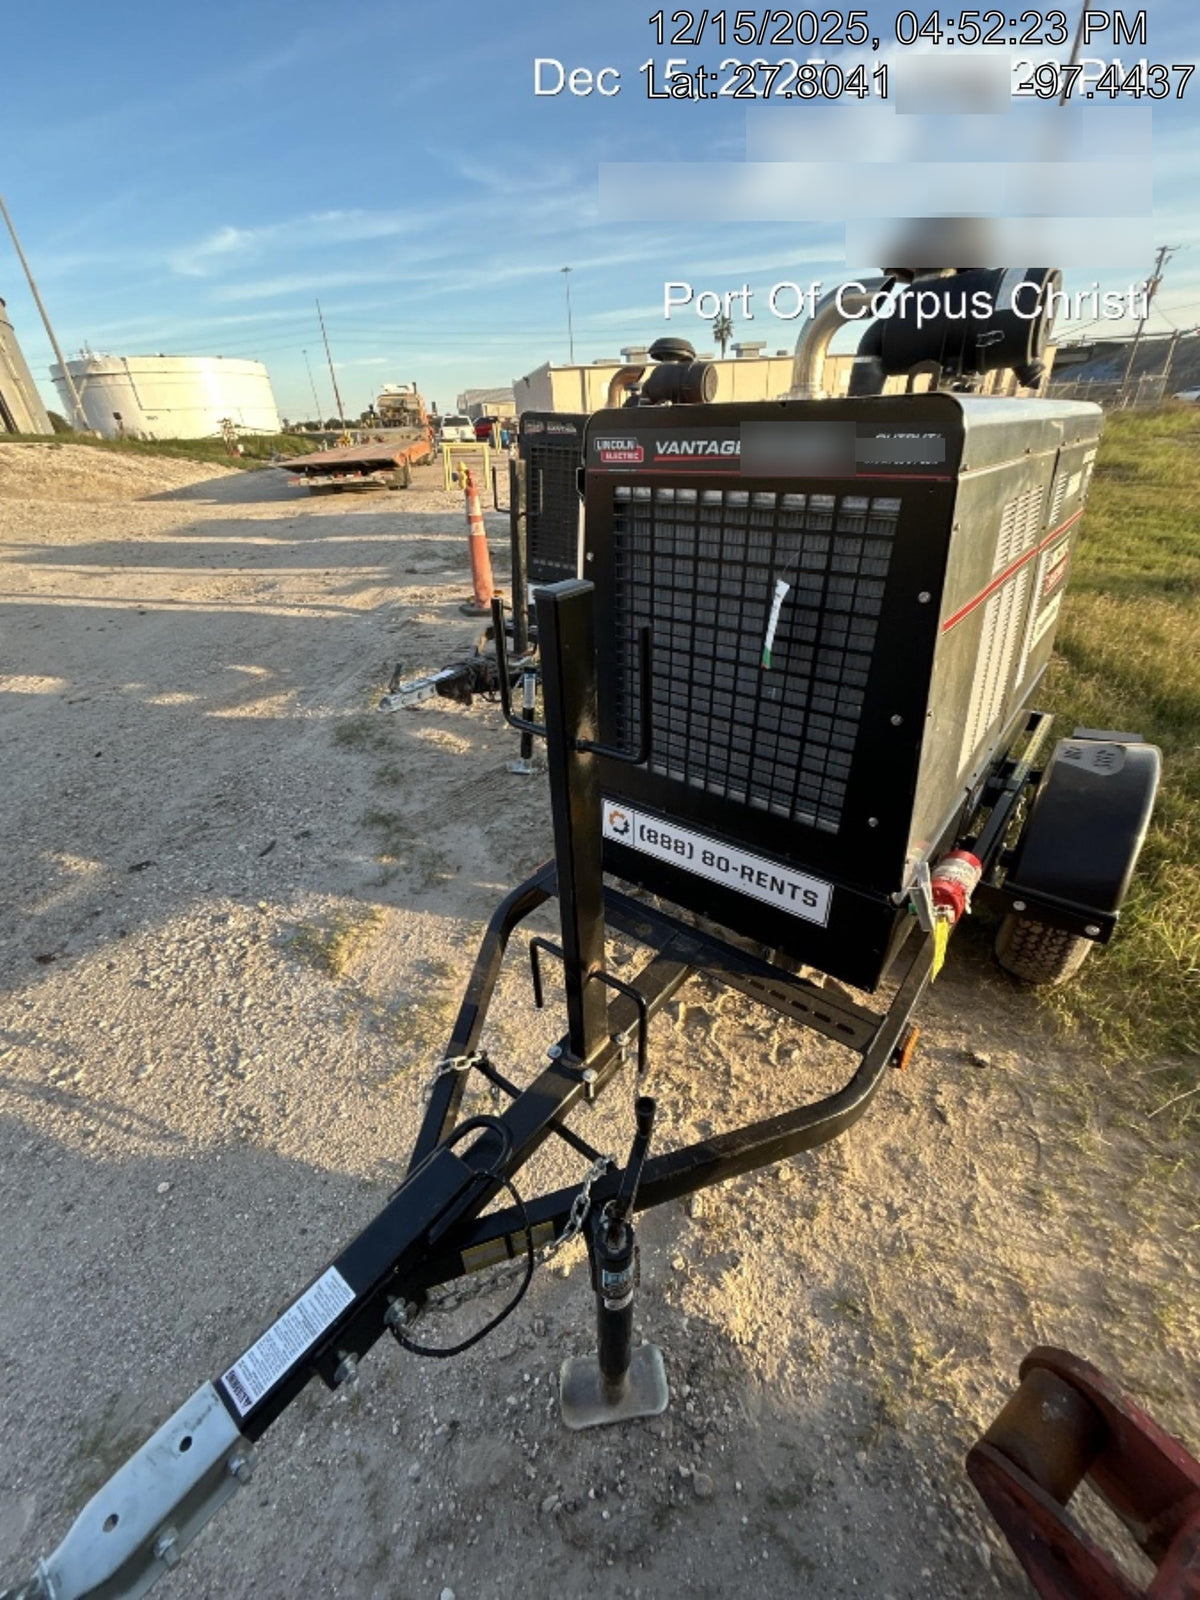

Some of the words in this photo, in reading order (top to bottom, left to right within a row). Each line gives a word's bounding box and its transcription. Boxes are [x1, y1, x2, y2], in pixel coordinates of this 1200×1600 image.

[596, 440, 634, 450] LINCOLN
[639, 824, 694, 860] (888)
[702, 850, 819, 908] 80-RENTS
